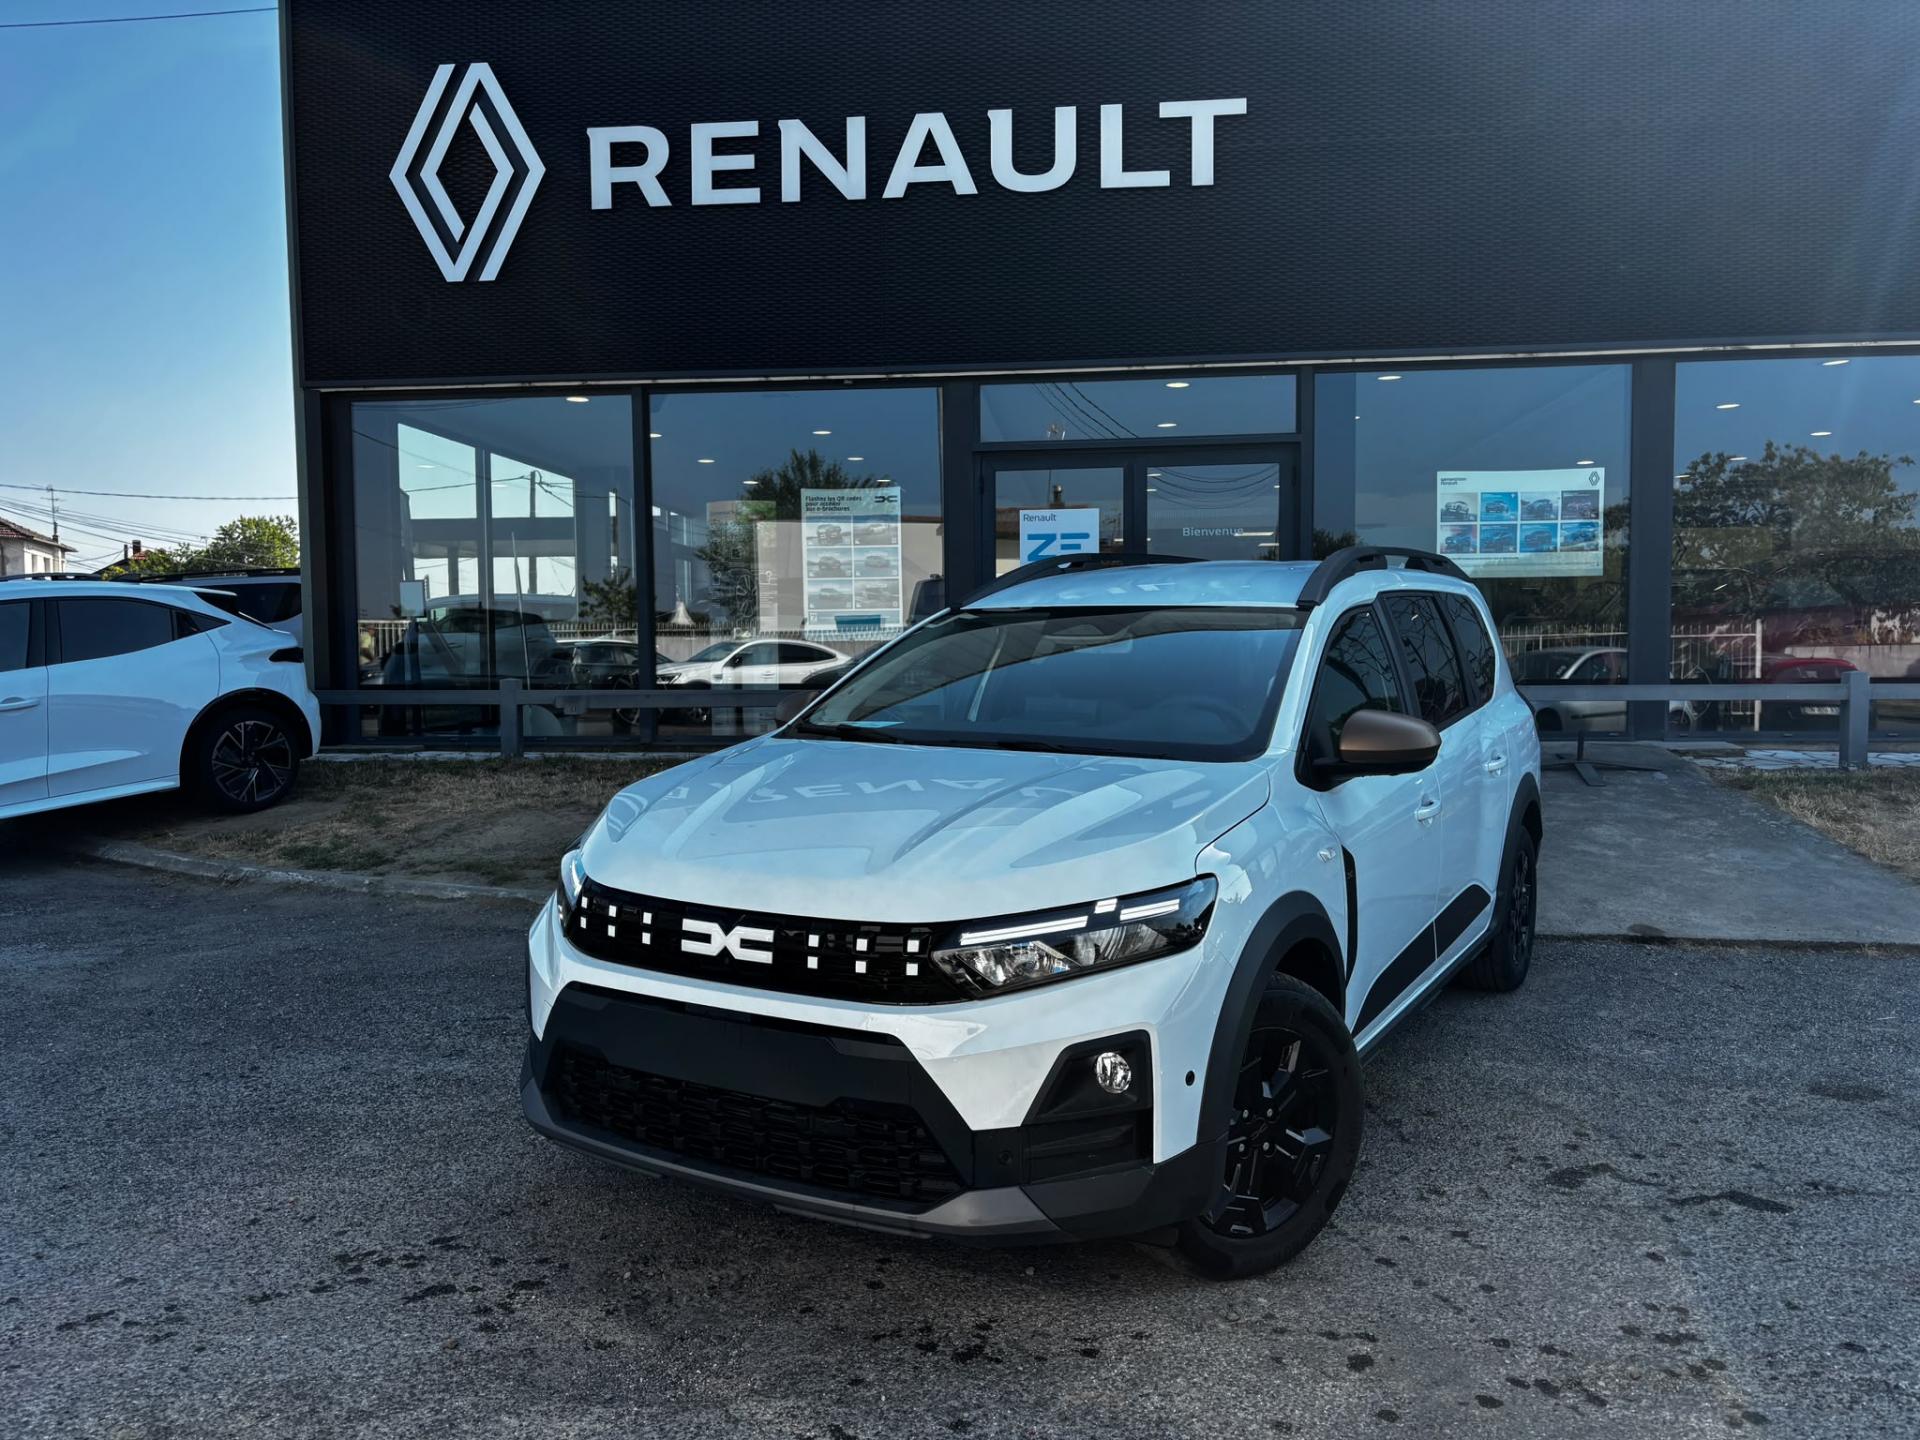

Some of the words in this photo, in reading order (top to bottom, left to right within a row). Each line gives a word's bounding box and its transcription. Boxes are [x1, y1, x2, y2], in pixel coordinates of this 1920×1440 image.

[586, 98, 1247, 210] RENAULT
[1023, 513, 1057, 522] Renault
[1182, 527, 1244, 537] Bienvenue
